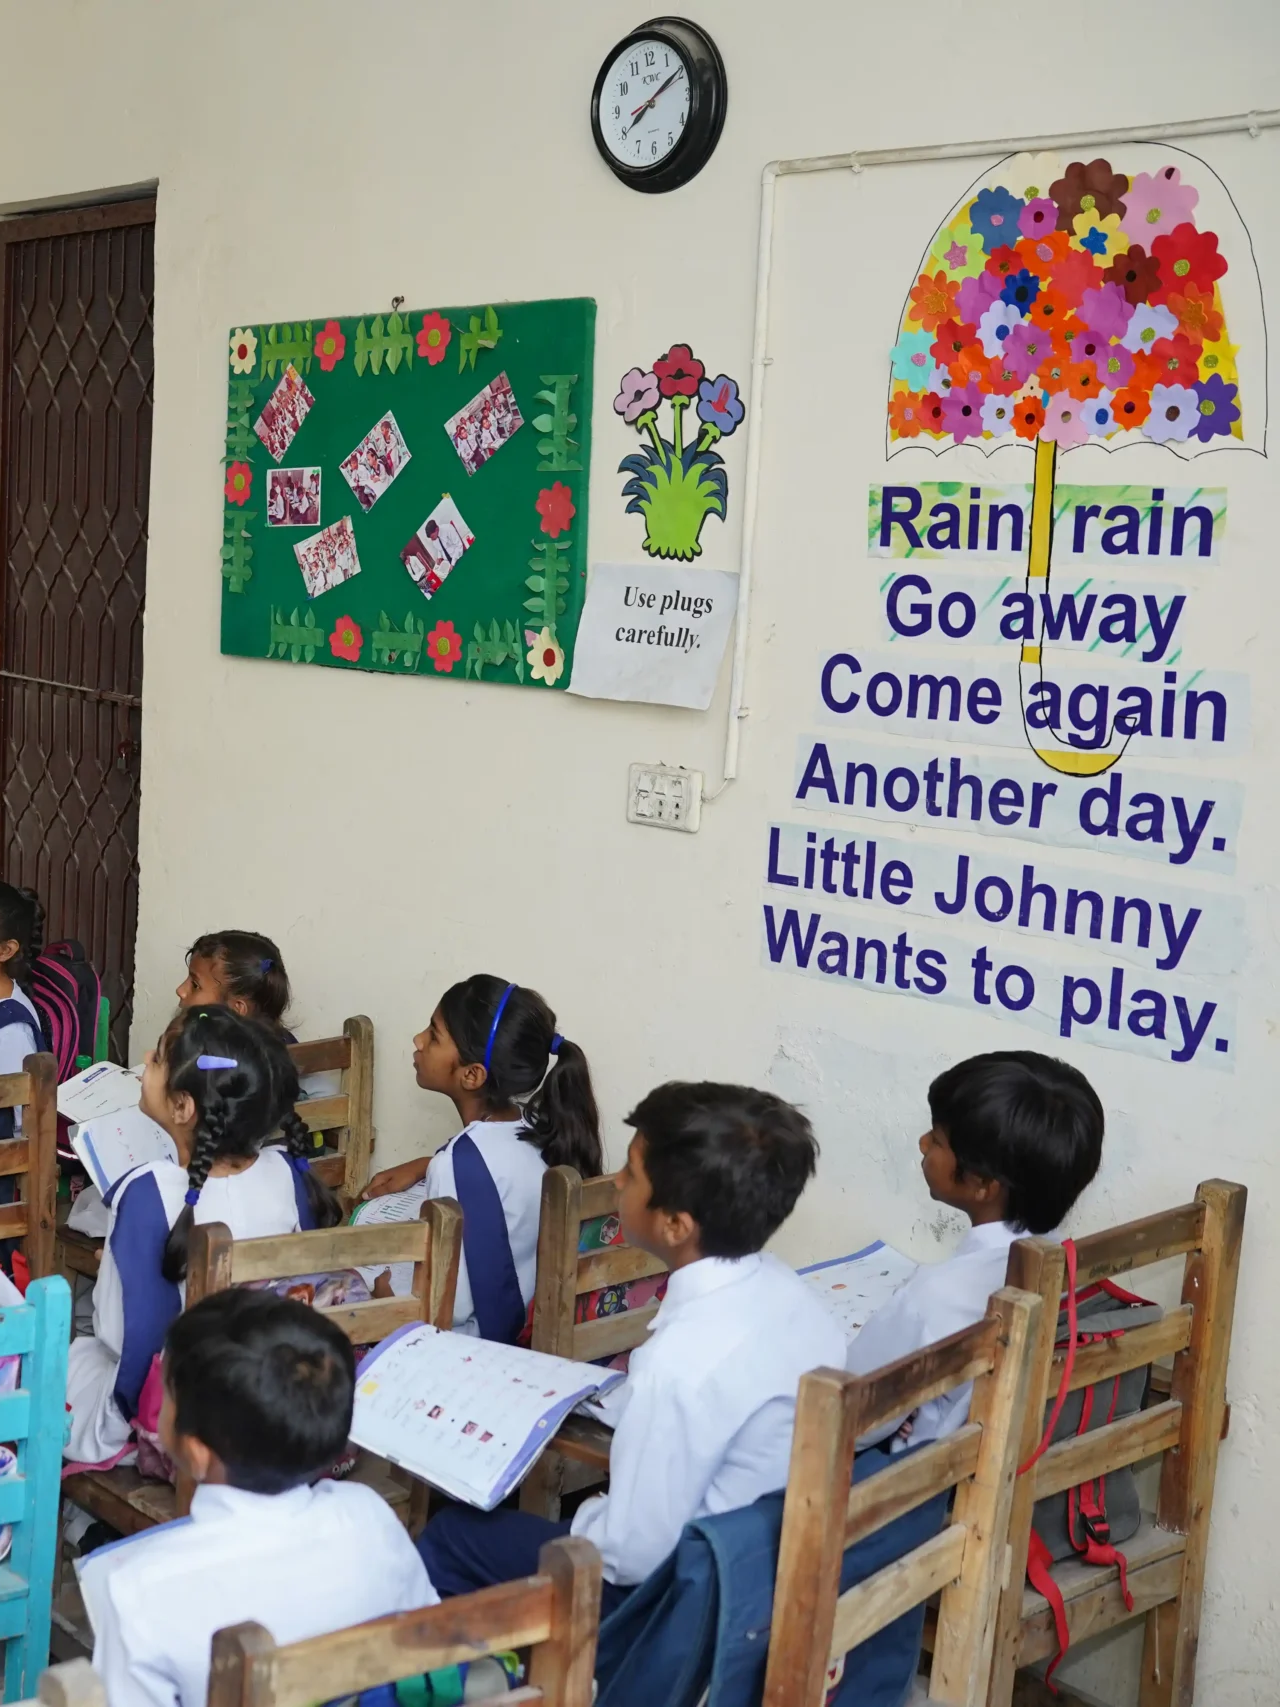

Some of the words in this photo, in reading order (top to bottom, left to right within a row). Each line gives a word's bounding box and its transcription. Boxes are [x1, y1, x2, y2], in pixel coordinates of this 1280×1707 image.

[644, 51, 655, 67] 12
[665, 53, 669, 67] 1
[631, 61, 639, 76] 11
[619, 81, 629, 97] 10
[685, 87, 690, 102] 3
[614, 105, 621, 120] 9
[679, 112, 686, 127] 4
[621, 126, 628, 141] 8
[668, 132, 673, 146] 5
[636, 140, 641, 154] 7
[651, 141, 658, 156] 6
[878, 485, 1024, 552] Rain
[1071, 488, 1214, 557] rain
[623, 586, 657, 609] Use
[659, 589, 714, 619] plugs
[885, 574, 977, 639] Go
[999, 592, 1187, 663] away
[615, 625, 701, 654] carefully.
[820, 653, 1003, 725] Come
[1024, 671, 1228, 749] again
[795, 742, 1058, 830] Another
[1078, 772, 1227, 866] day.
[767, 827, 915, 906] Little
[934, 854, 1203, 972] Johnny
[763, 904, 948, 996] Wants
[970, 946, 1036, 1012] to
[1059, 967, 1229, 1063] play.
